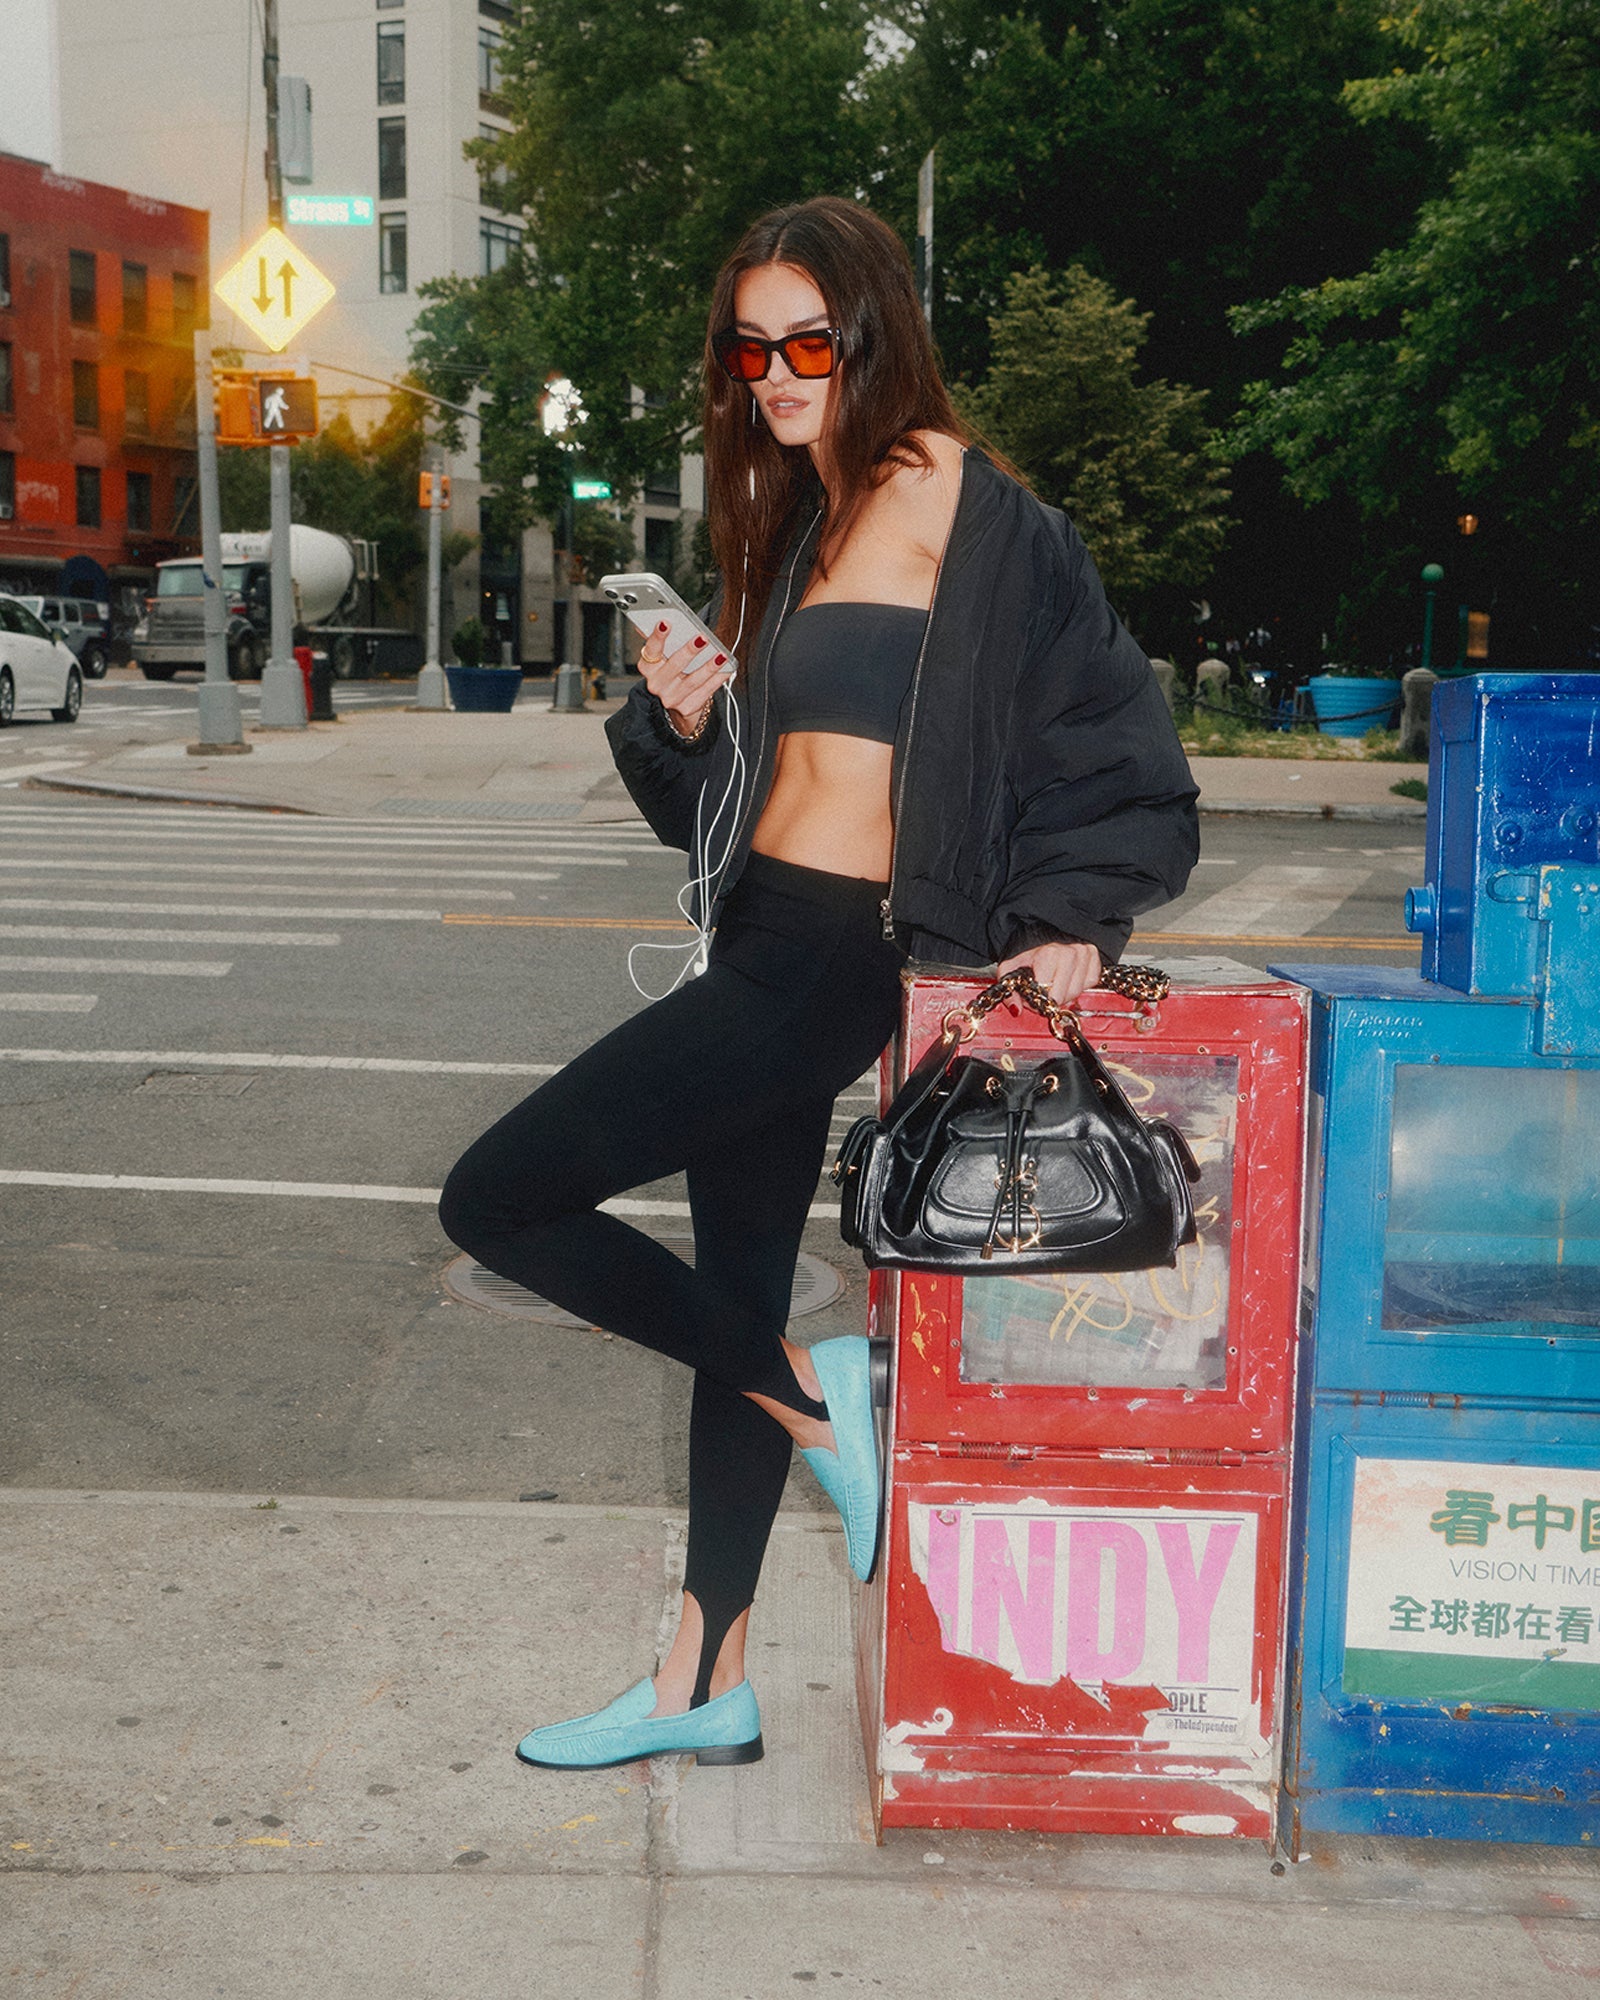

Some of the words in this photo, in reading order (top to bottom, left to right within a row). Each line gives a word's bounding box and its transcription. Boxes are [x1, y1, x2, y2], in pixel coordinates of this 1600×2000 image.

[1449, 1558, 1537, 1583] VISION
[926, 1509, 1242, 1684] INDY
[1388, 1594, 1600, 1645] 全球都在看
